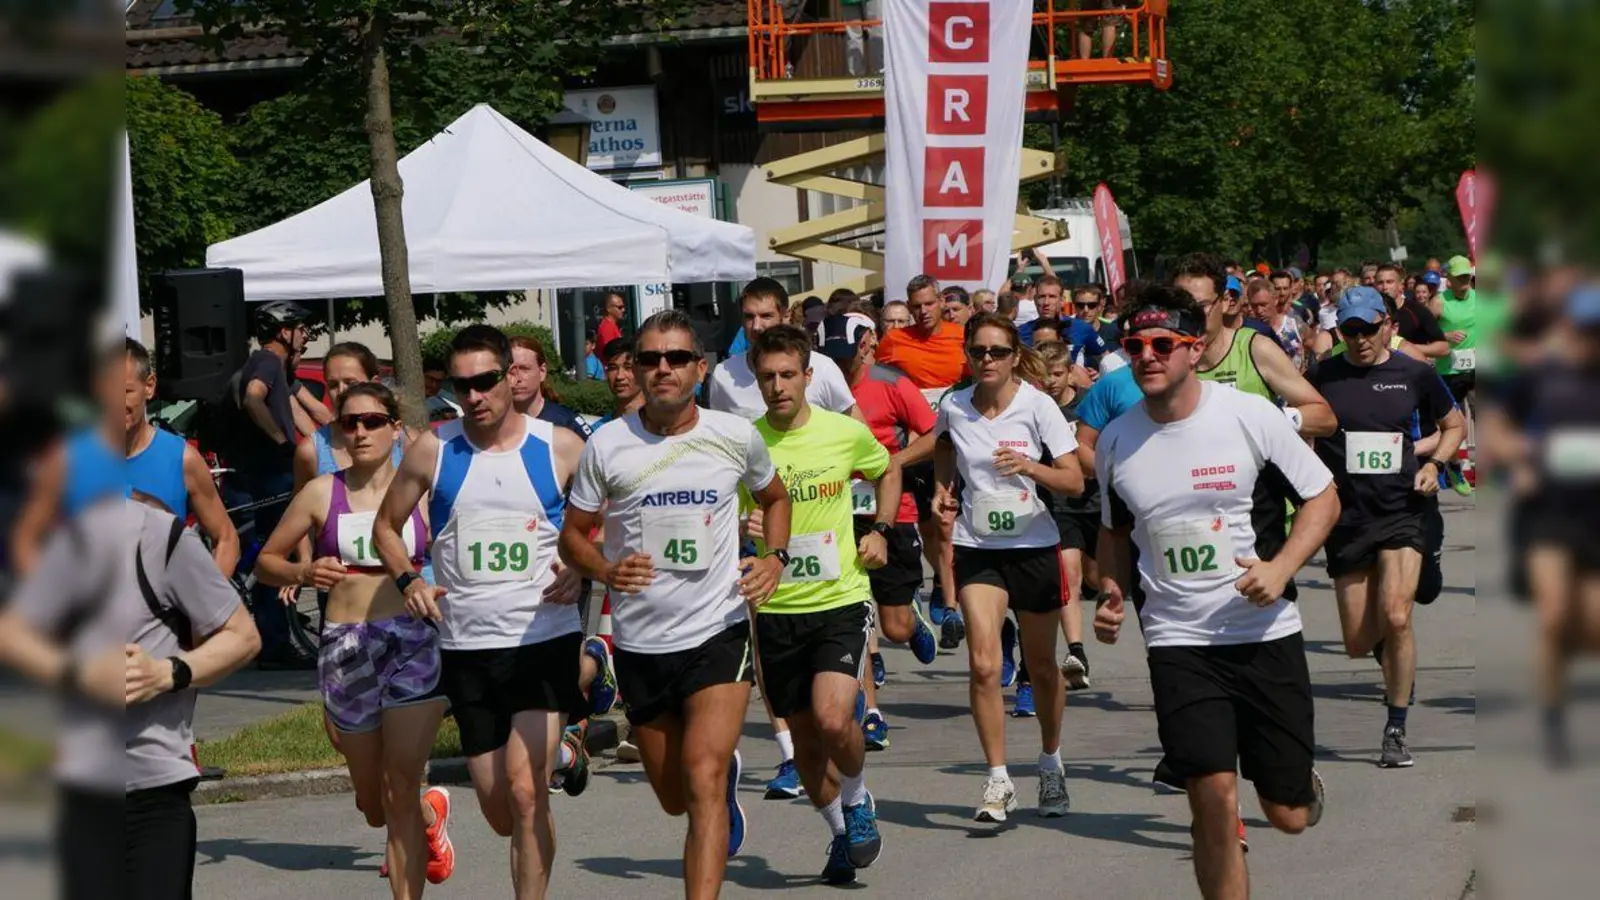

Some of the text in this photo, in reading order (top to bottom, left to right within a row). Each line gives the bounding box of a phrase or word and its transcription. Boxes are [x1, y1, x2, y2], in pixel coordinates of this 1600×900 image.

[1459, 358, 1473, 368] 73
[1356, 451, 1392, 469] 163
[640, 489, 719, 507] AIRBUS
[988, 510, 1016, 531] 98
[467, 541, 529, 572] 139
[663, 538, 698, 565] 45
[1163, 544, 1219, 574] 102
[789, 555, 821, 578] 26
